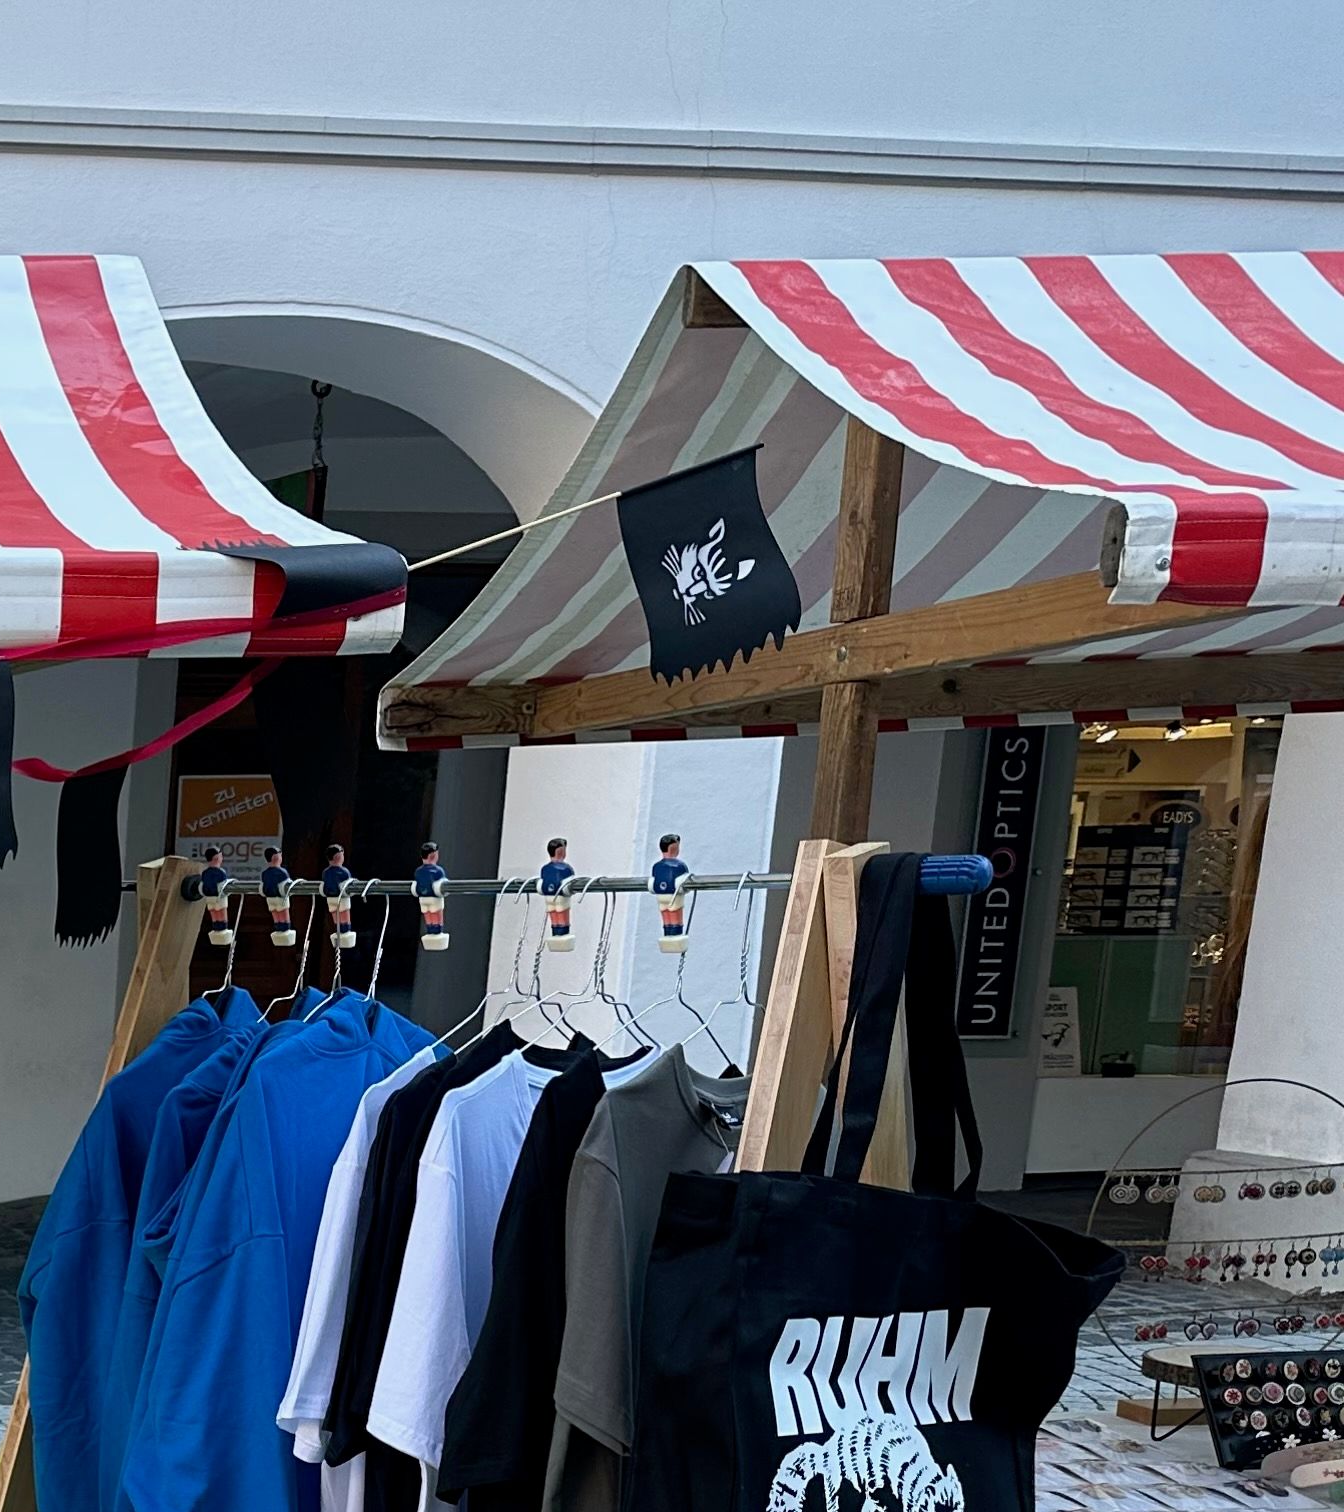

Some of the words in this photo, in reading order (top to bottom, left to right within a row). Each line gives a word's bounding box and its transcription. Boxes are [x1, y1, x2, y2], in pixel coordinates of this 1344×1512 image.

[186, 791, 274, 833] vermieten
[971, 887, 1010, 1024] UNITED
[991, 737, 1030, 878] OPTICS
[769, 1306, 991, 1437] RUHM
